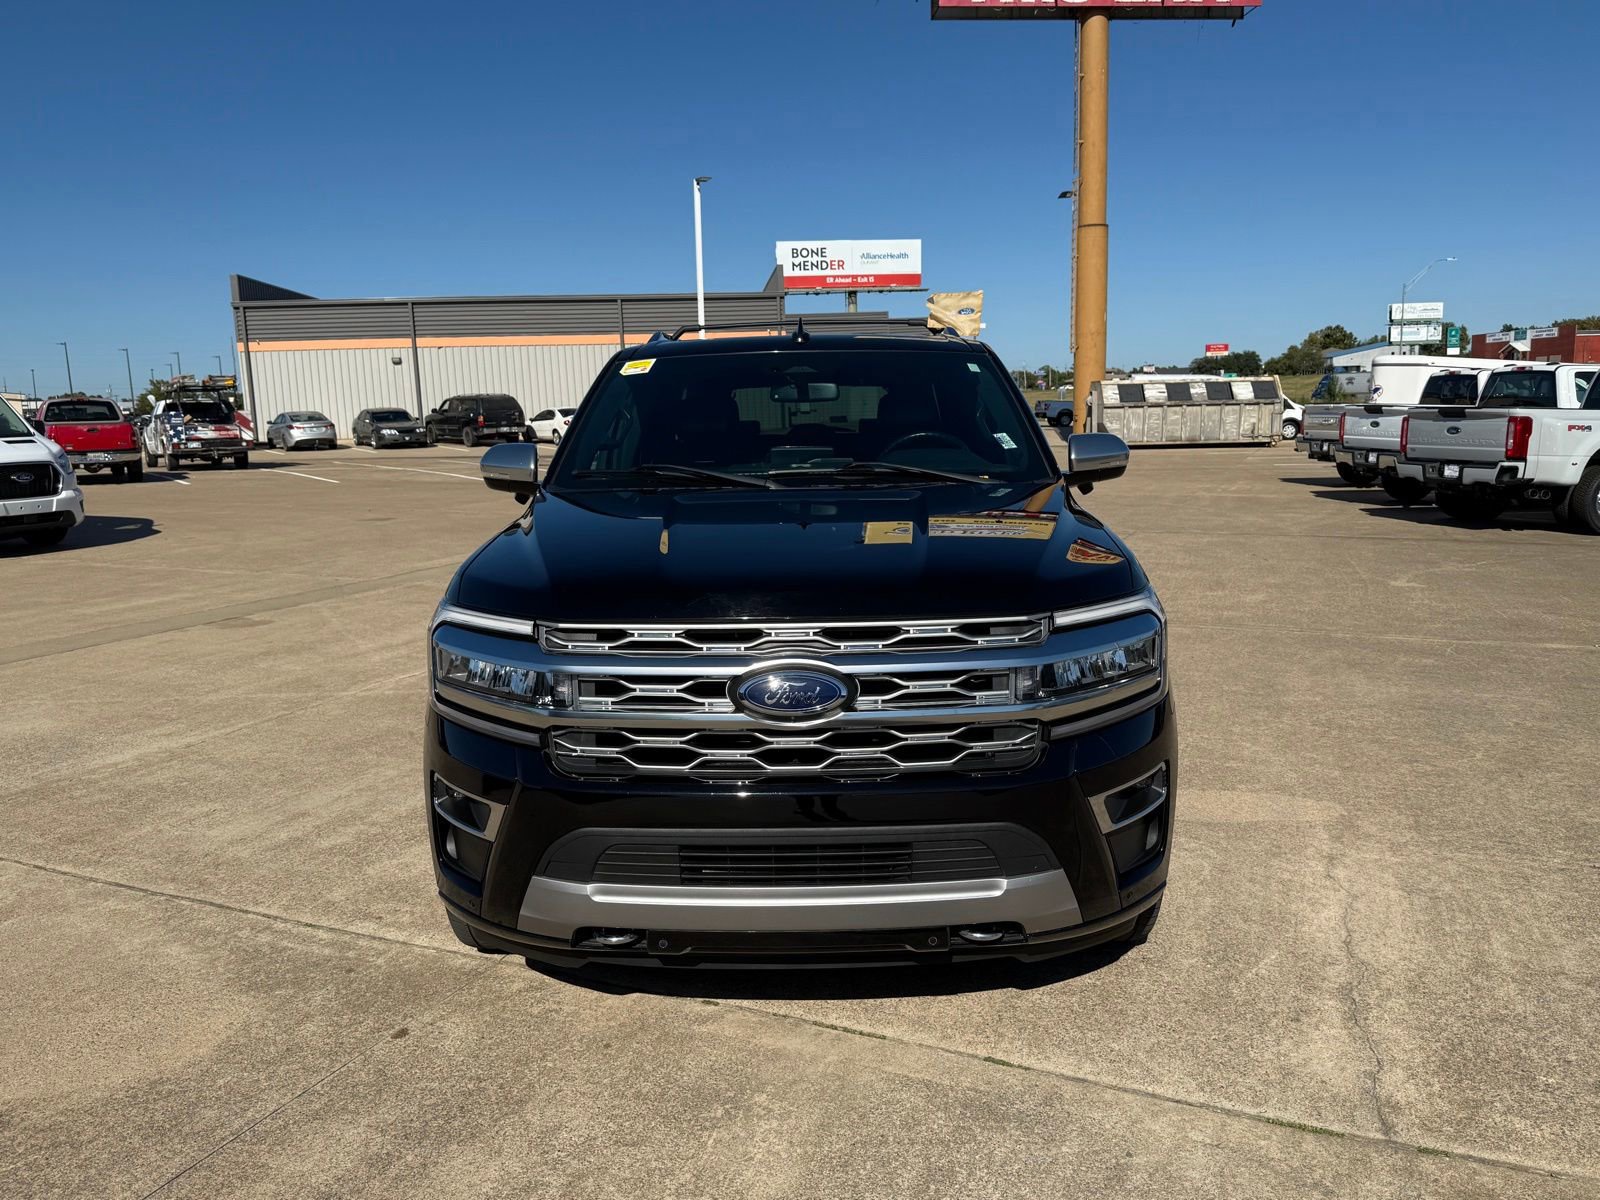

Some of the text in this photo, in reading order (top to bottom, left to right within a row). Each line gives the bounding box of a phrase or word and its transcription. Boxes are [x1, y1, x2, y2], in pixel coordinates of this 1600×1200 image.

[791, 247, 827, 259] BONE
[860, 251, 909, 260] AllianceHealth
[791, 259, 845, 272] MENDER
[1567, 424, 1592, 432] FX4
[764, 680, 821, 705] Ford
